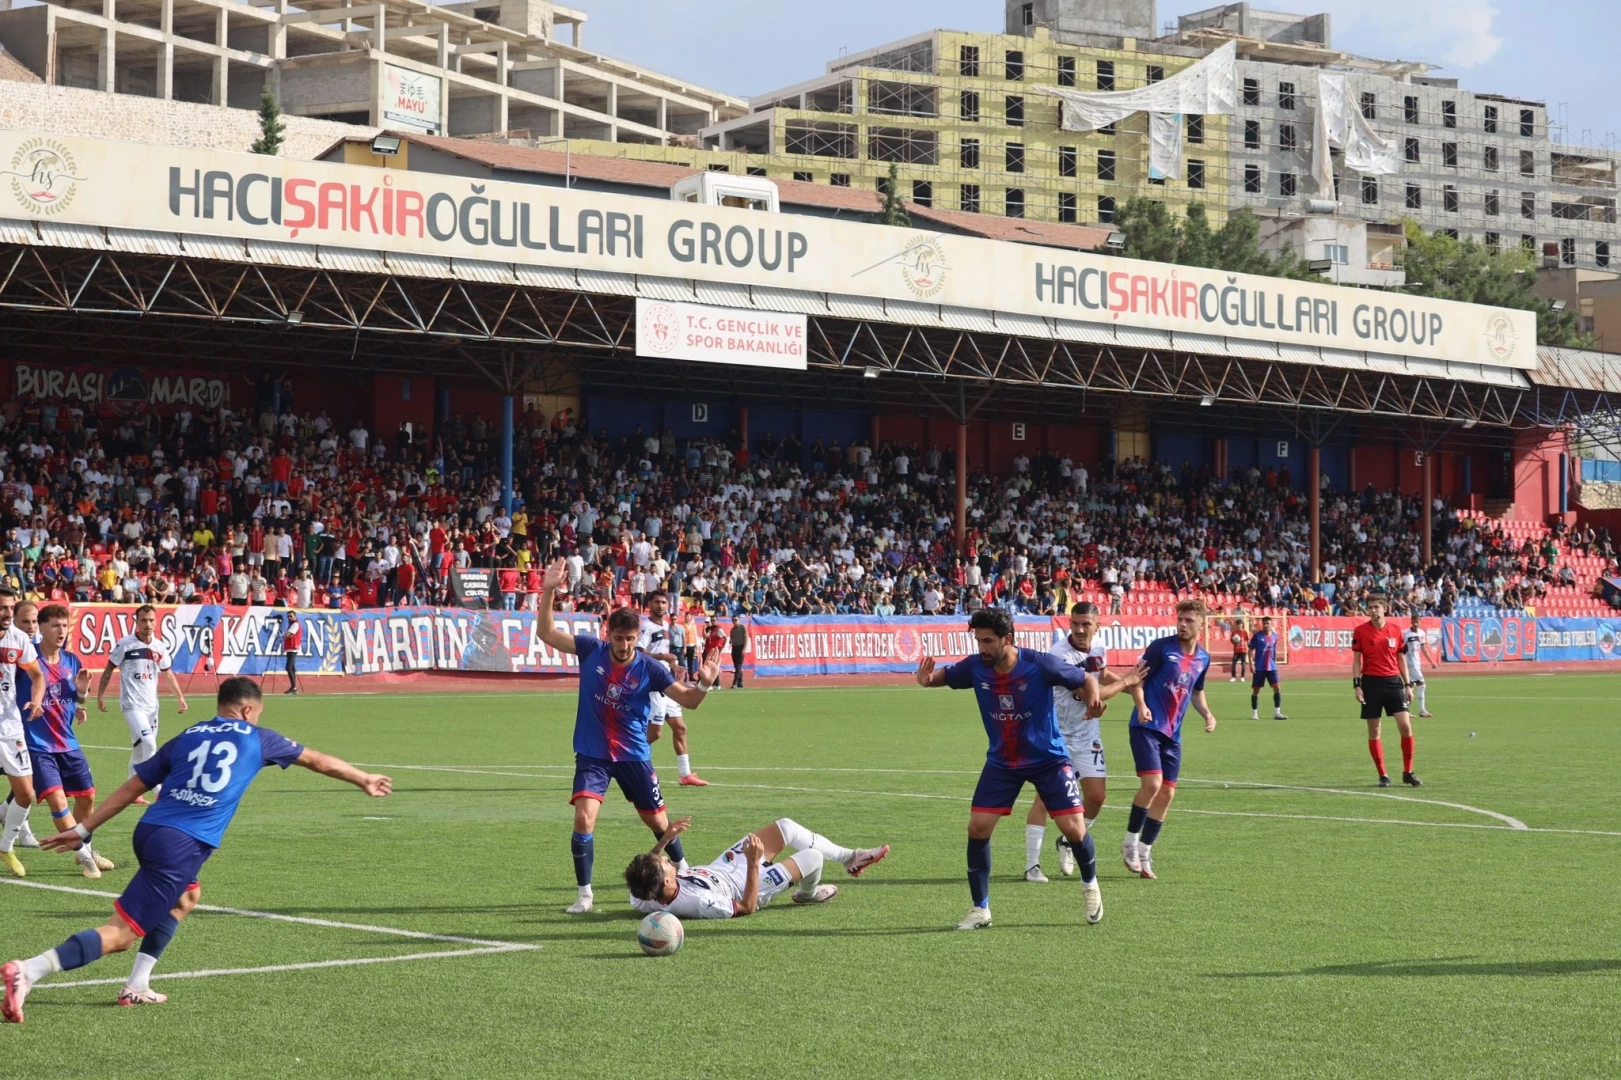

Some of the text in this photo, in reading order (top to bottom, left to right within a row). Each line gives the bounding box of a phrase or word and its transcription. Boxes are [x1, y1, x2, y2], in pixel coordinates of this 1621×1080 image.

[398, 96, 425, 114] MAYU
[169, 166, 808, 273] HACIŞAKİROĞULLARI GROUP
[1036, 262, 1443, 346] HACIŞAKİROĞULLARI GROUP
[686, 315, 802, 338] T.C. GENÇLİK VE
[686, 333, 803, 356] SPOR BAKANLIĞI
[16, 364, 104, 405] BURASI
[694, 404, 706, 421] D
[1013, 424, 1024, 439] E
[1278, 442, 1288, 456] F
[182, 624, 214, 656] ve
[221, 614, 326, 657] KAZN
[921, 631, 946, 657] SUAL
[1304, 625, 1322, 647] BİZ
[1323, 630, 1336, 647] BU
[186, 740, 238, 793] 13
[1065, 780, 1080, 797] 23
